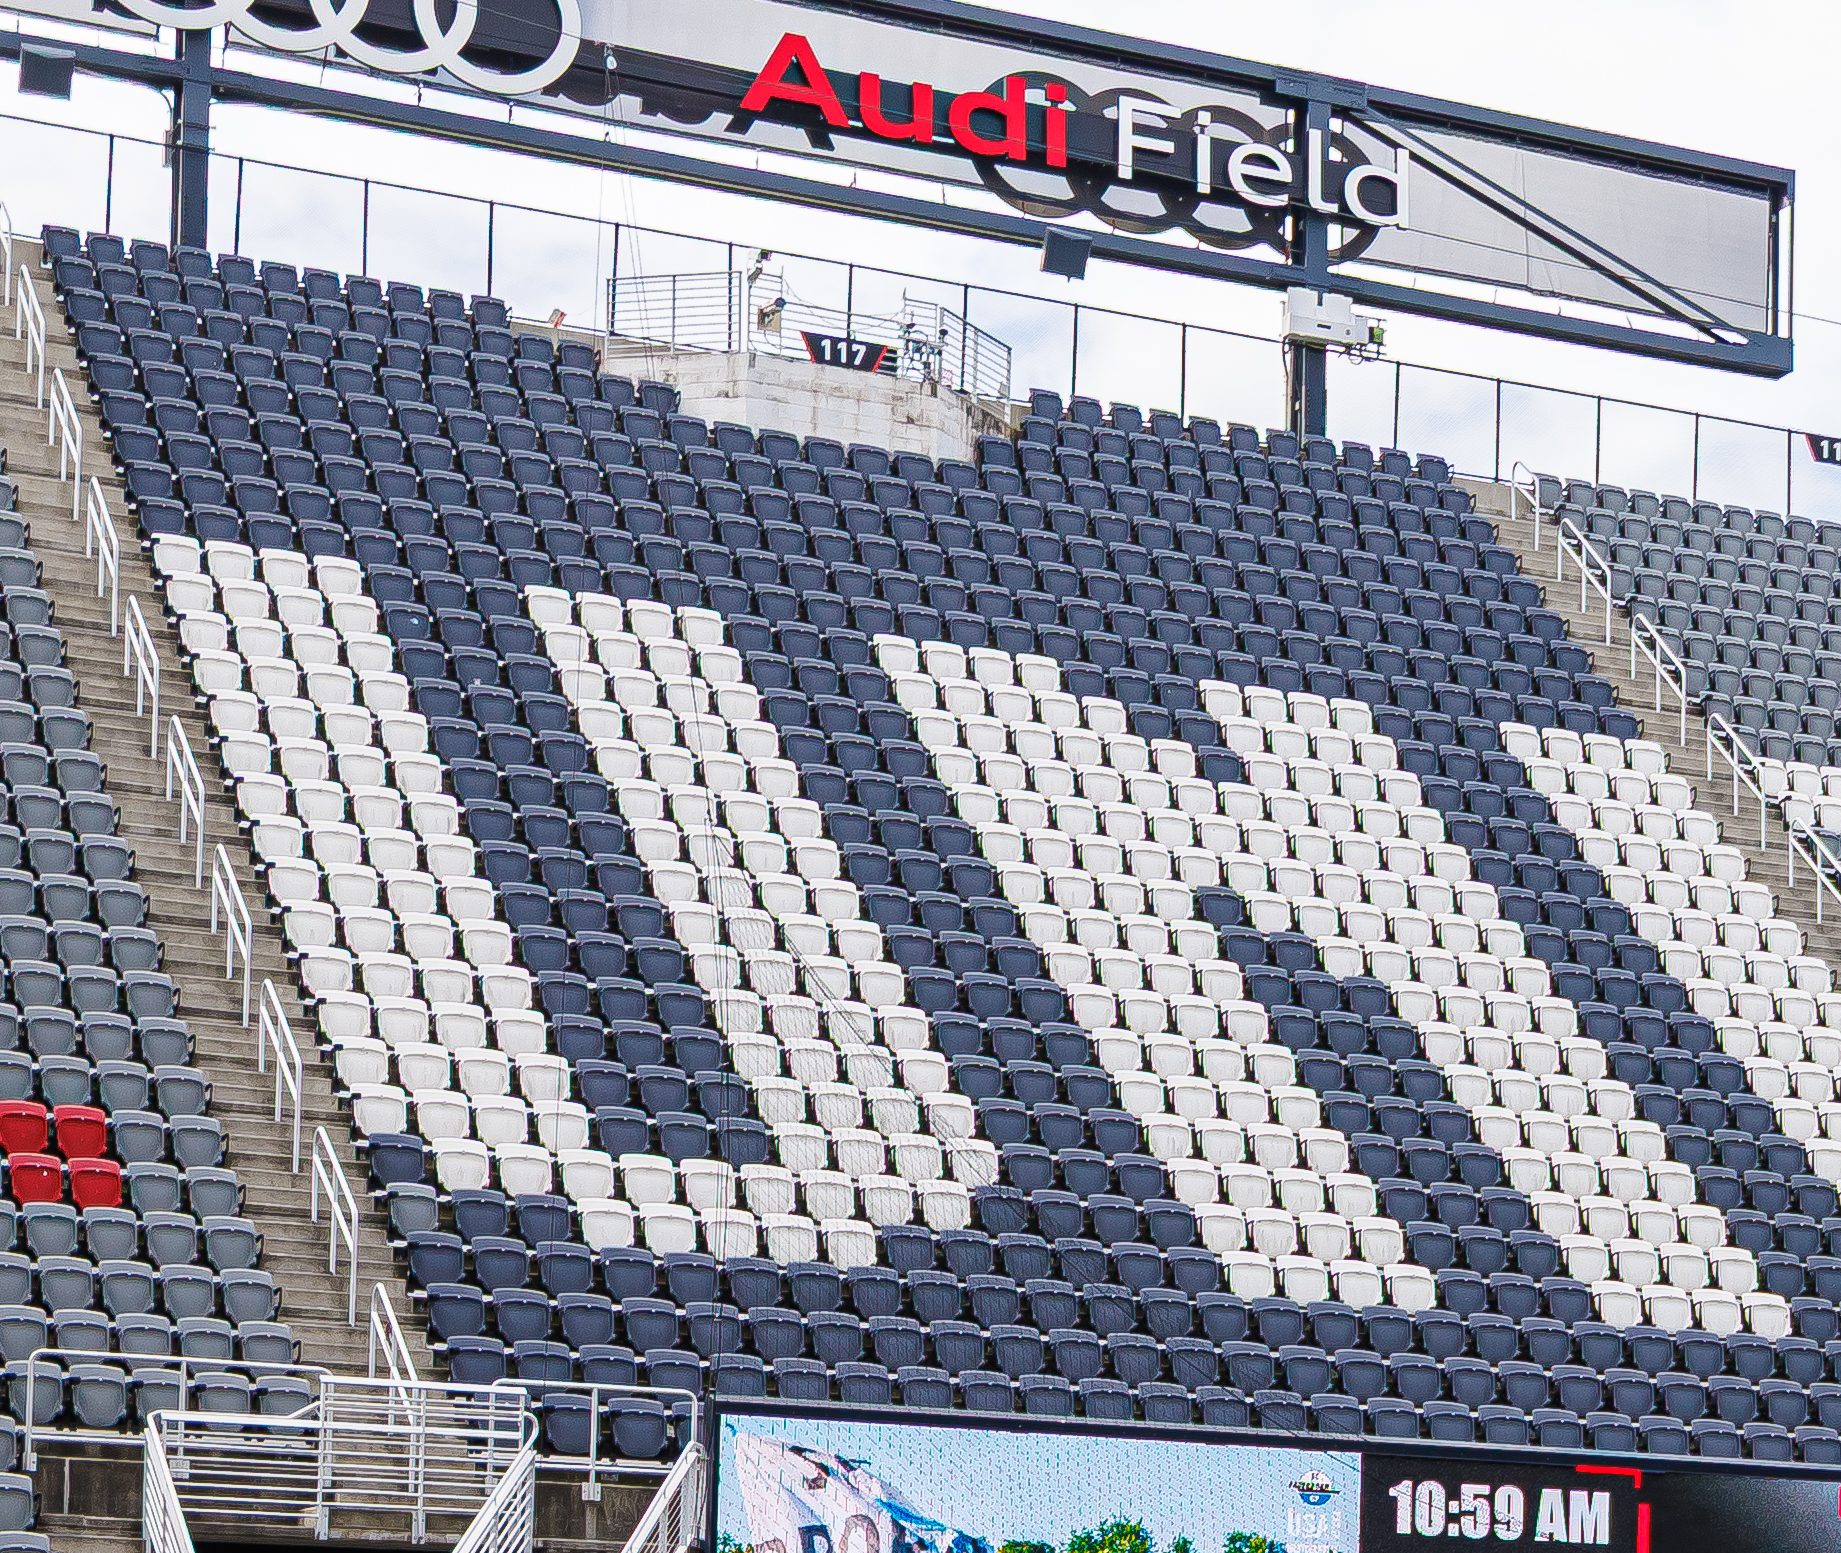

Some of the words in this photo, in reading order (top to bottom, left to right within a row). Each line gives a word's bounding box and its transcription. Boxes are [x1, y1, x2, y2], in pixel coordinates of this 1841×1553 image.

[740, 31, 1068, 169] Audi
[1116, 95, 1410, 230] Field
[820, 338, 866, 366] 117
[1388, 1479, 1525, 1541] 10:59
[1534, 1487, 1611, 1545] AM
